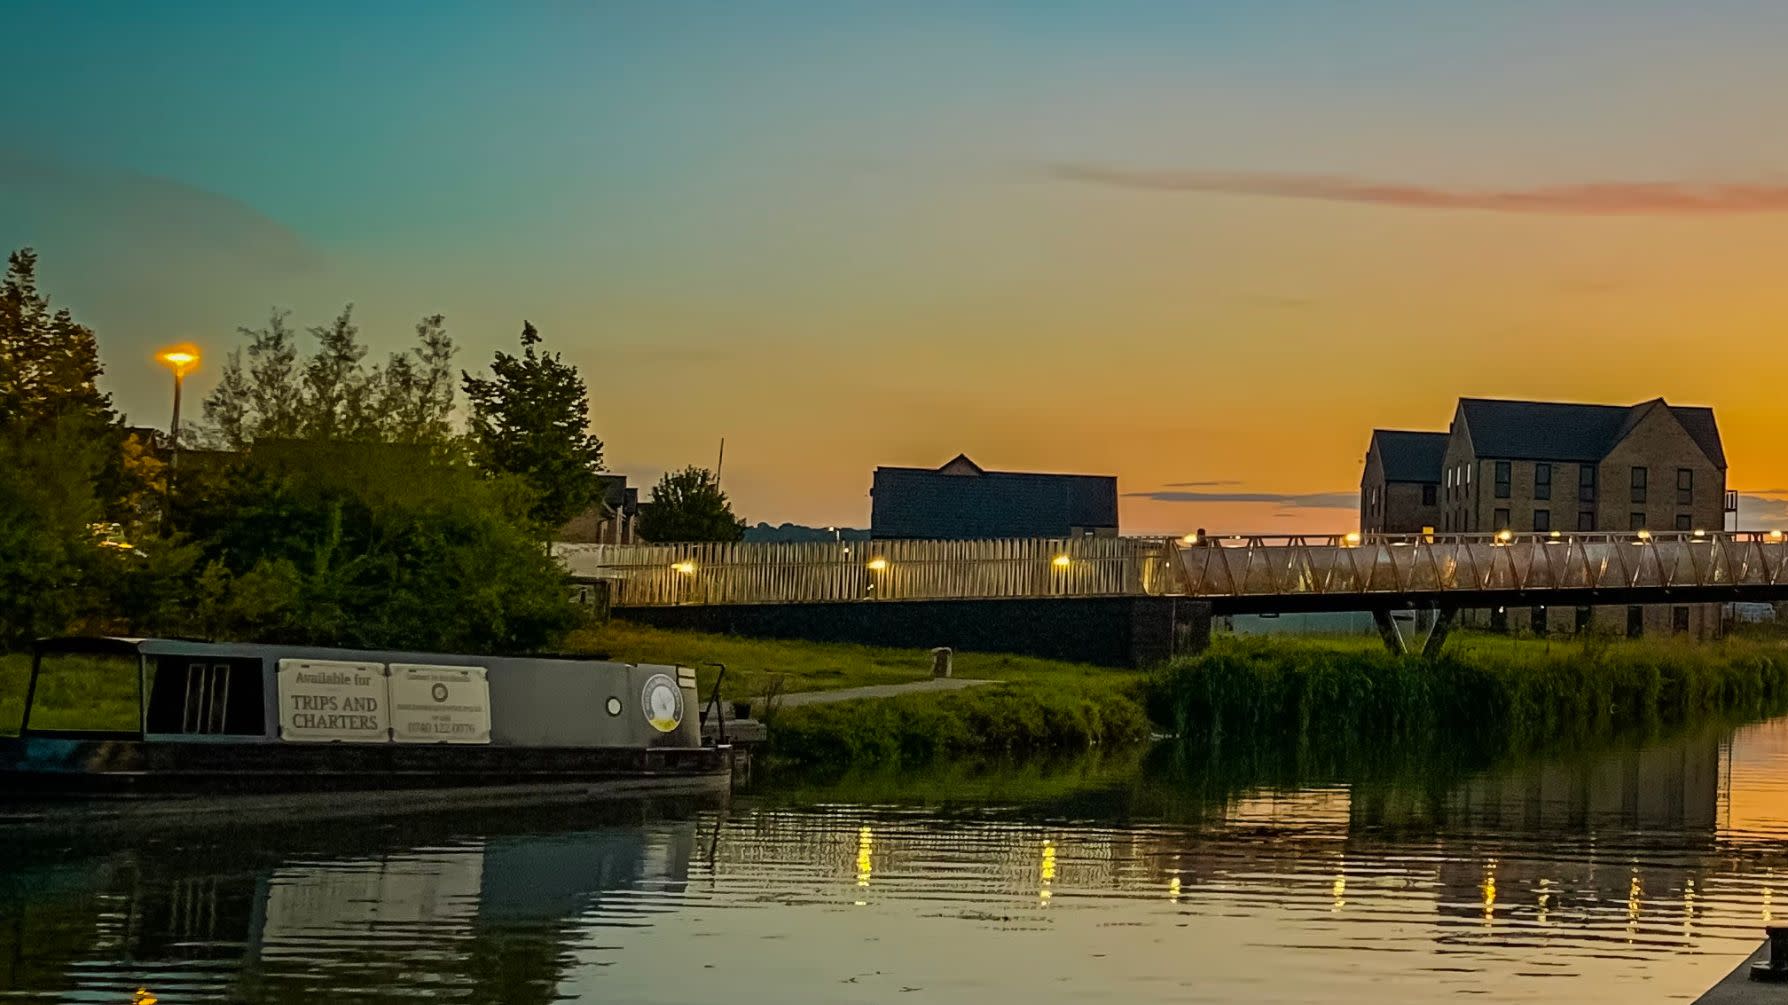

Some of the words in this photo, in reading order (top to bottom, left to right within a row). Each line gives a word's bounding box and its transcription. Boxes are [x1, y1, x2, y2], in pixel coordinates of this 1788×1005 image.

[296, 671, 351, 685] Available
[354, 673, 371, 686] for
[291, 695, 338, 711] TRIPS
[343, 697, 378, 712] AND
[292, 714, 378, 730] CHARTERS
